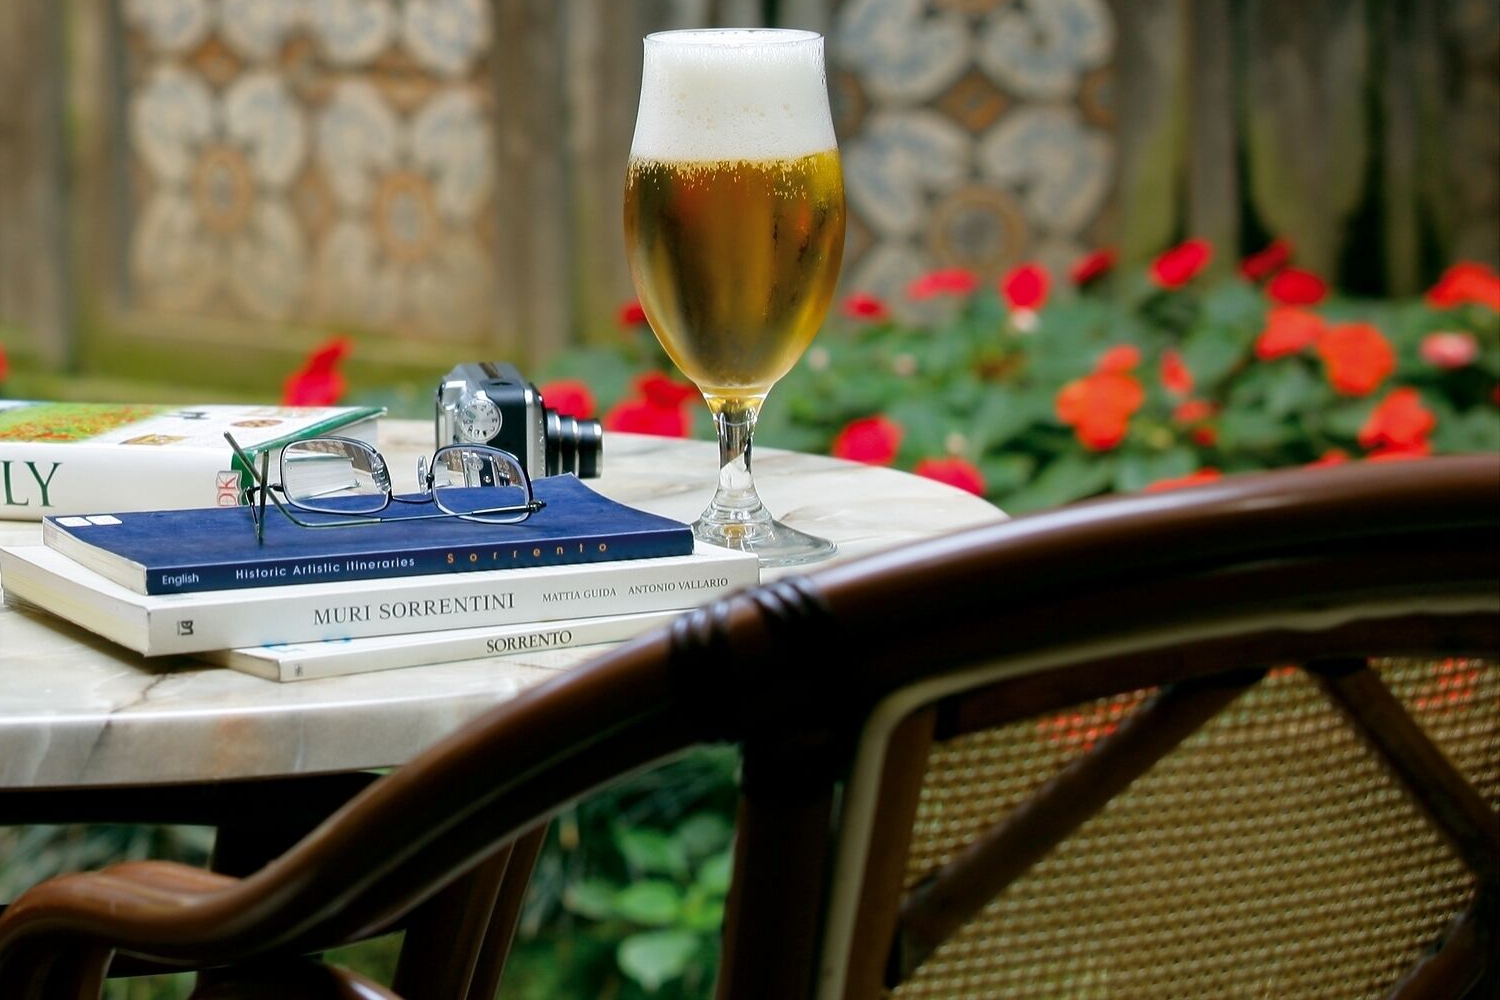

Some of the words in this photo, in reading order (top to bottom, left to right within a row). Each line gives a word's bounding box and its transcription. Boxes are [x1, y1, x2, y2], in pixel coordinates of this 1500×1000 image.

[218, 474, 238, 507] DK
[446, 543, 607, 563] Sorrento
[161, 573, 200, 588] English
[235, 567, 286, 580] Historic
[292, 562, 341, 576] Artistic
[542, 591, 582, 603] MATTIA
[583, 587, 617, 599] GUIDA
[628, 583, 677, 596] ANTONIO
[678, 577, 729, 591] VALLARIO
[313, 604, 371, 626] MURI
[378, 592, 516, 620] SORRENTINI
[486, 629, 573, 654] SORRENTO
